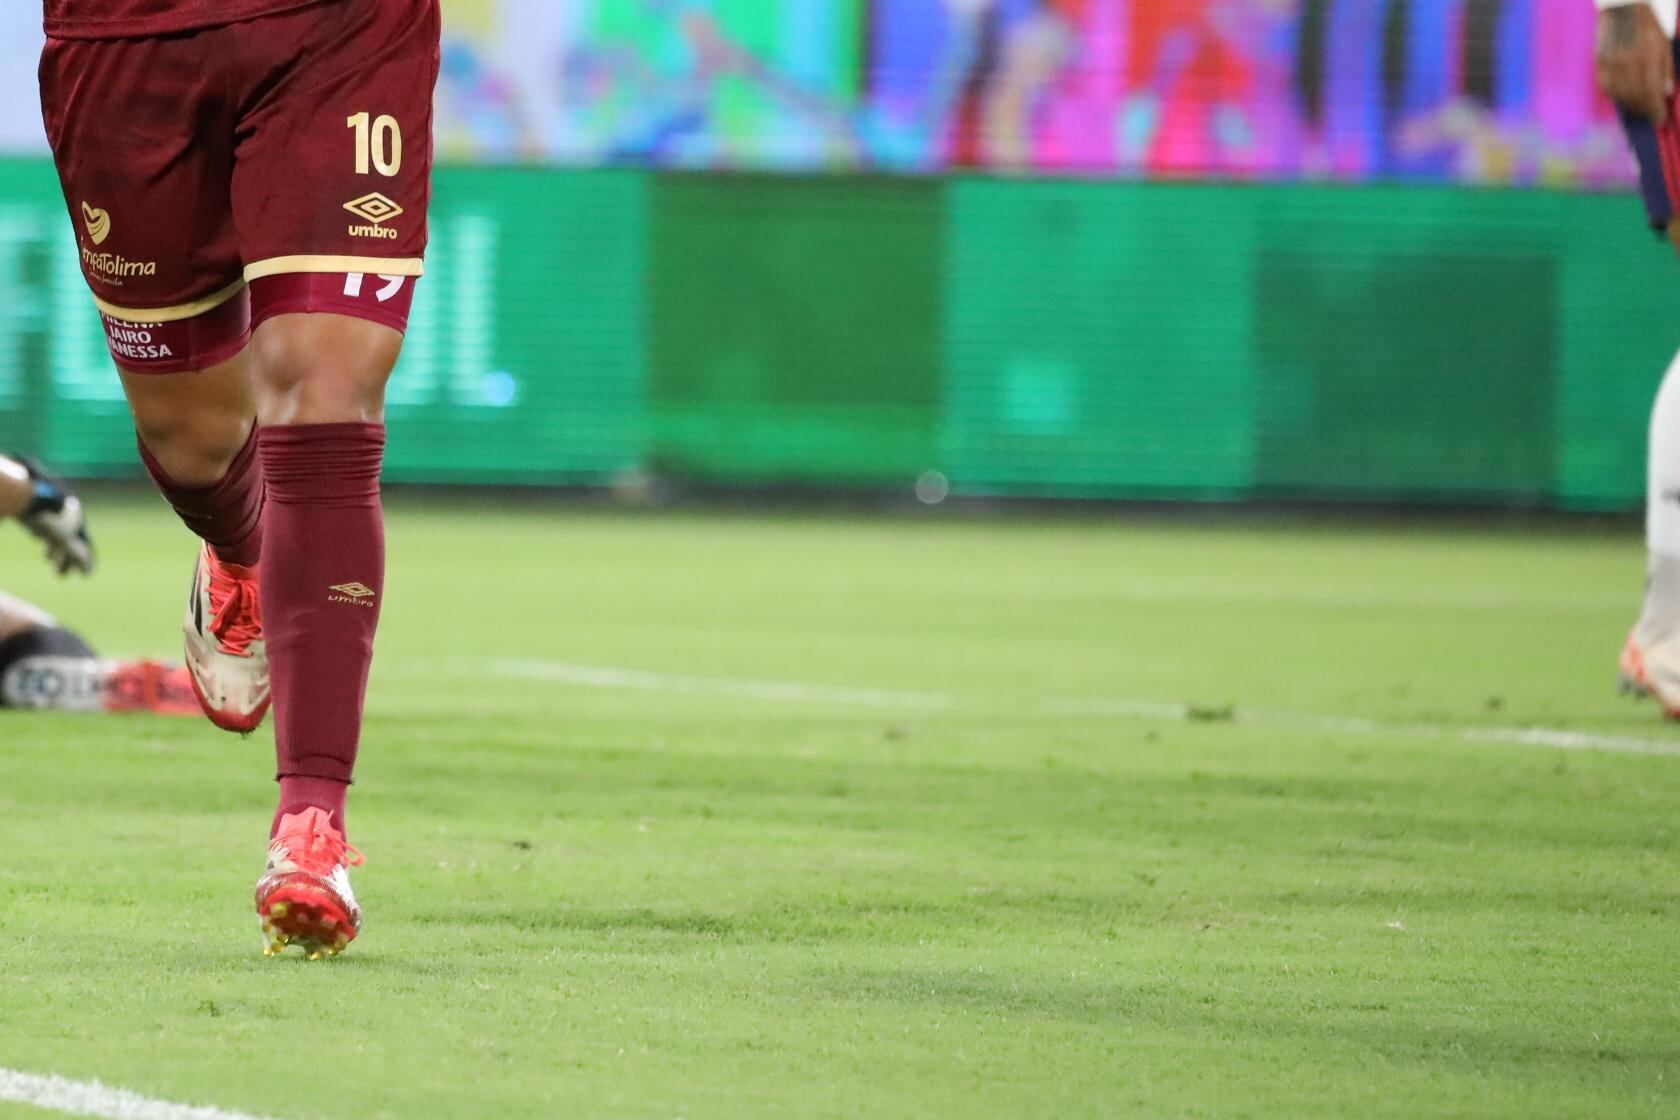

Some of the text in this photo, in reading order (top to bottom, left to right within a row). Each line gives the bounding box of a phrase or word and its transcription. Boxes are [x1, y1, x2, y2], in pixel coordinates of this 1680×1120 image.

[346, 111, 402, 178] 10
[348, 223, 397, 240] umbro
[80, 236, 156, 276] mfaTolima
[328, 595, 374, 608] umbro
